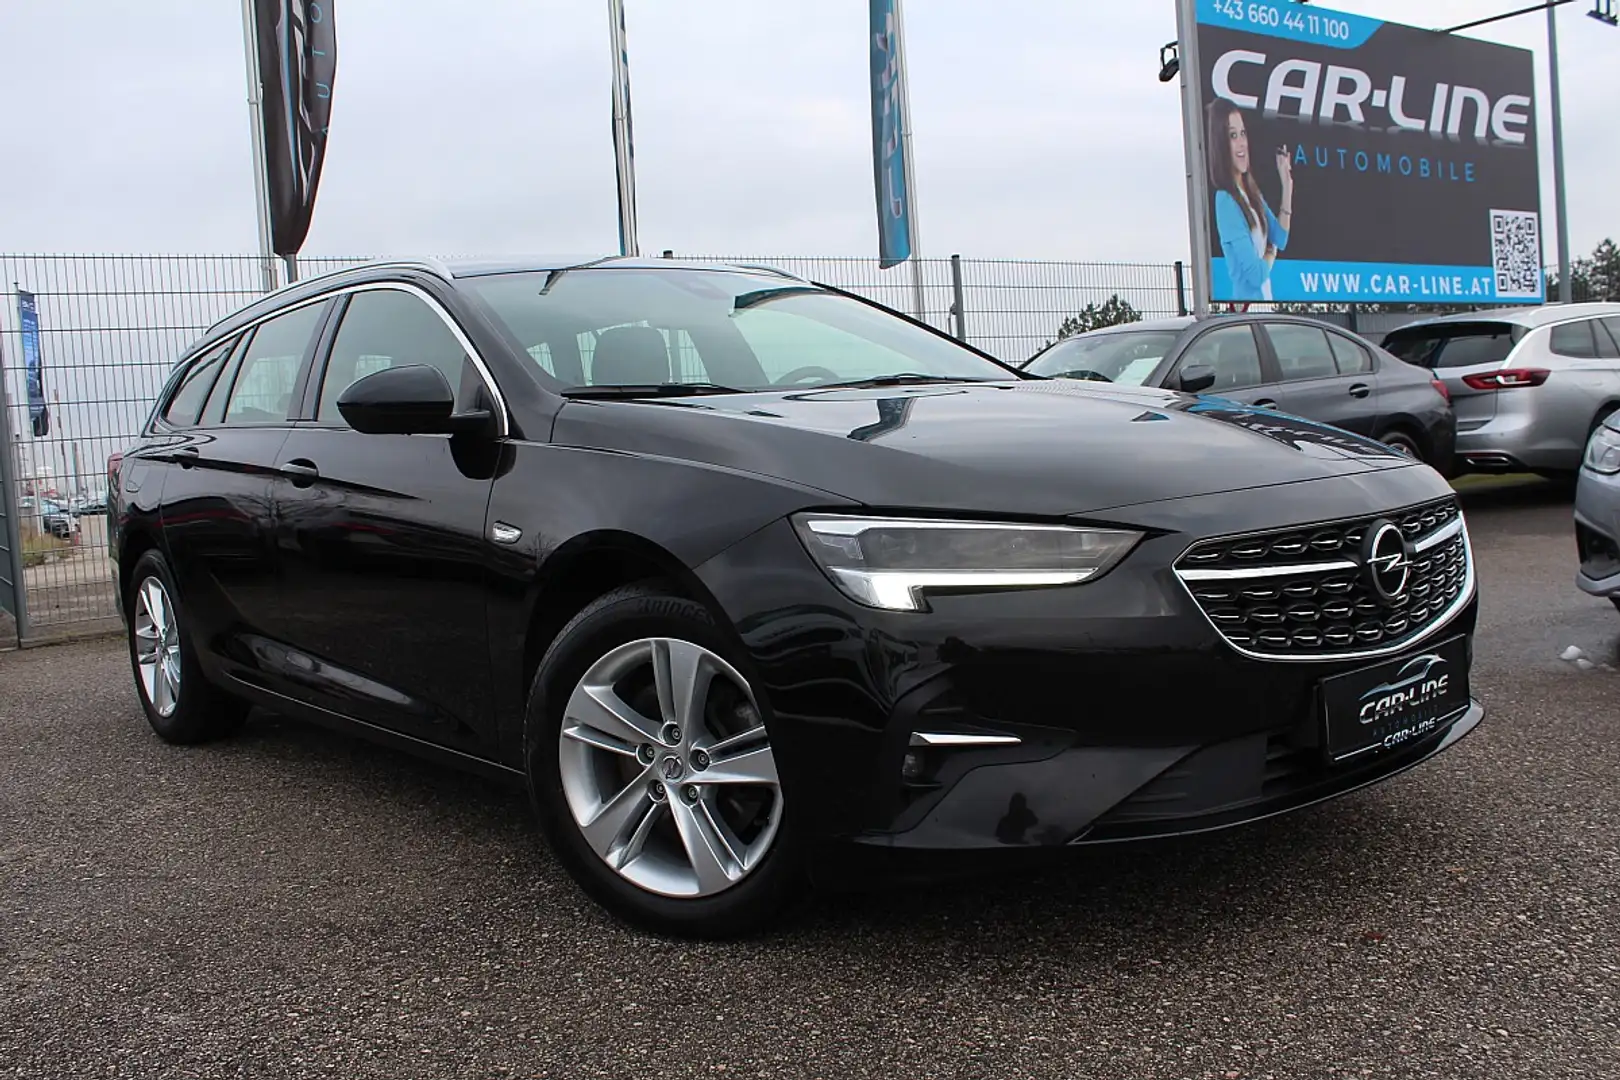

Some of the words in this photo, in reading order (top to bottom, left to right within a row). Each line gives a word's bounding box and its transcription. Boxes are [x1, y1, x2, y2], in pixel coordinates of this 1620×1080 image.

[1213, 0, 1244, 20] +43
[1248, 4, 1279, 27] 660
[1283, 10, 1305, 32] 44
[1307, 15, 1320, 35] 11
[1323, 18, 1349, 40] 100
[1211, 49, 1531, 144] CAR-LINE
[1294, 143, 1476, 182] AUTOMOBILE
[1300, 271, 1492, 296] WWW.CAR-LINE.AT
